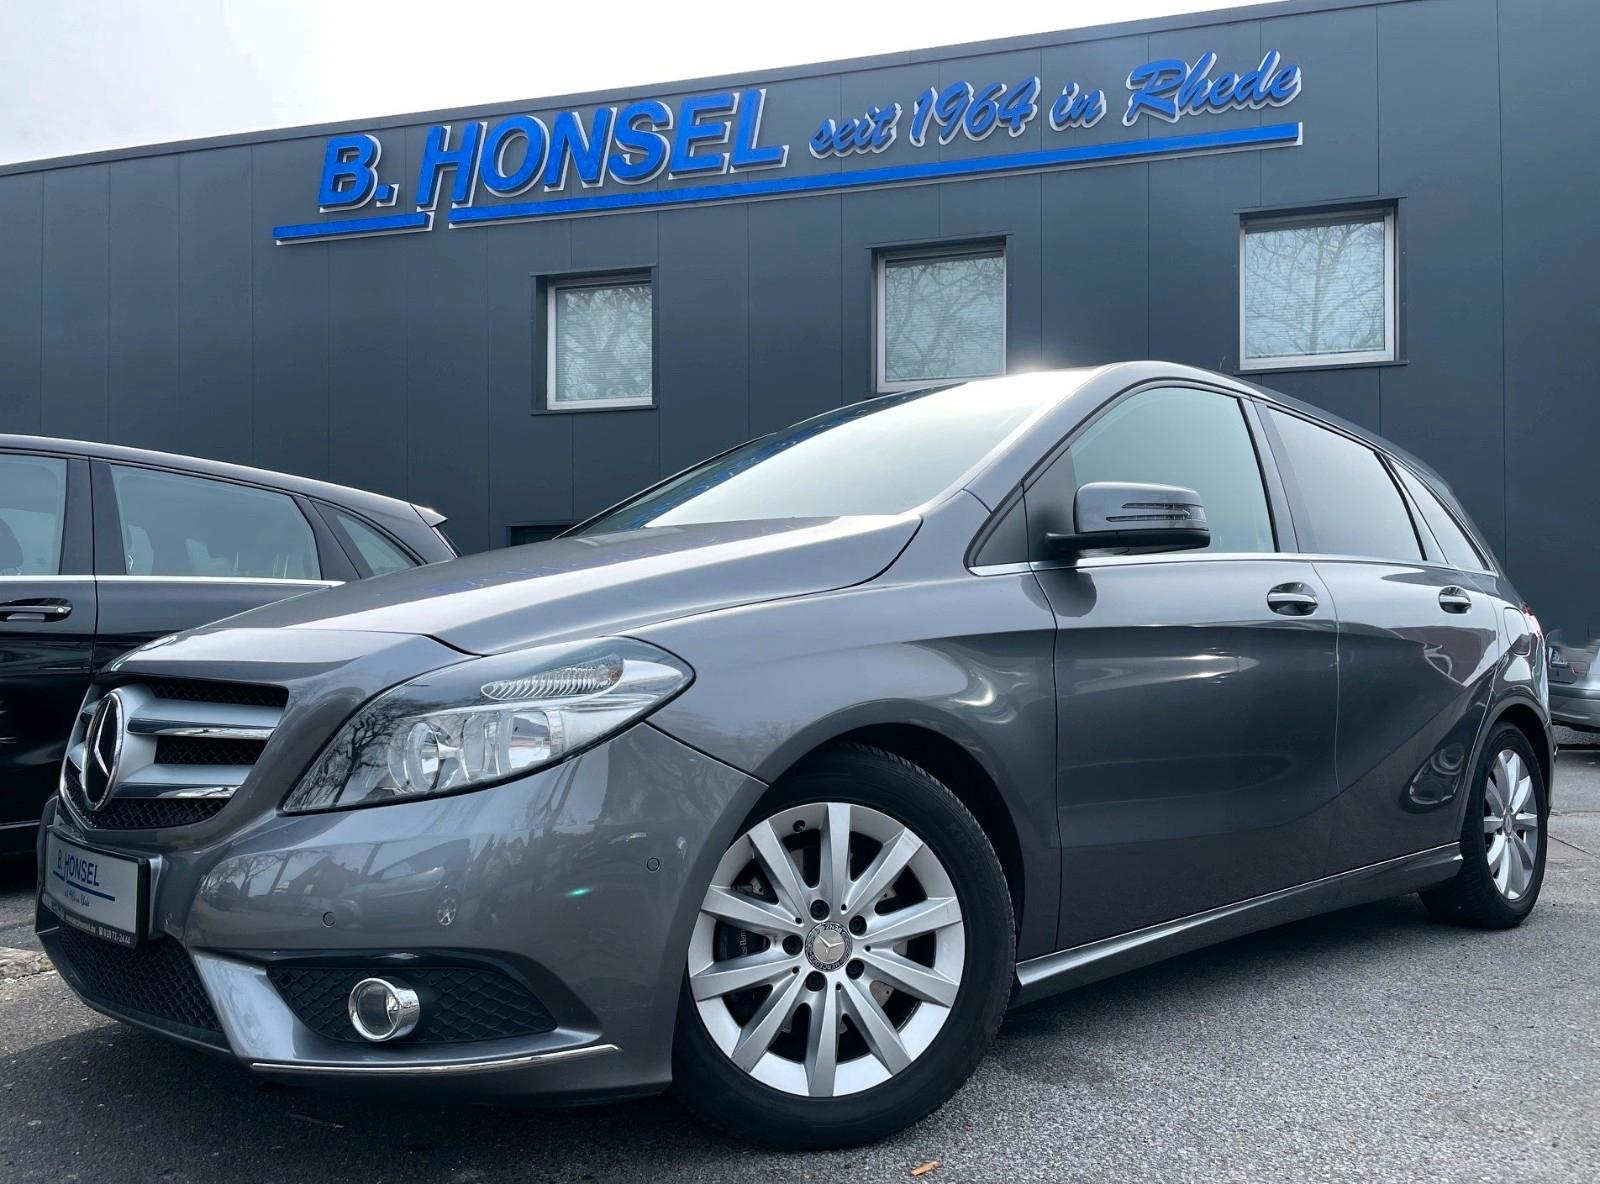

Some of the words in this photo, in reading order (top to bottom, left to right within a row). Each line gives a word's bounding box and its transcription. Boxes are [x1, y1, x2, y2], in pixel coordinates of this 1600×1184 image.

[318, 134, 399, 213] B.
[416, 88, 789, 212] HONSEL
[809, 102, 902, 159] seit
[910, 75, 1041, 145] 1964
[1049, 83, 1107, 131] in
[1122, 49, 1301, 126] Rhede
[64, 853, 100, 887] HONSEL
